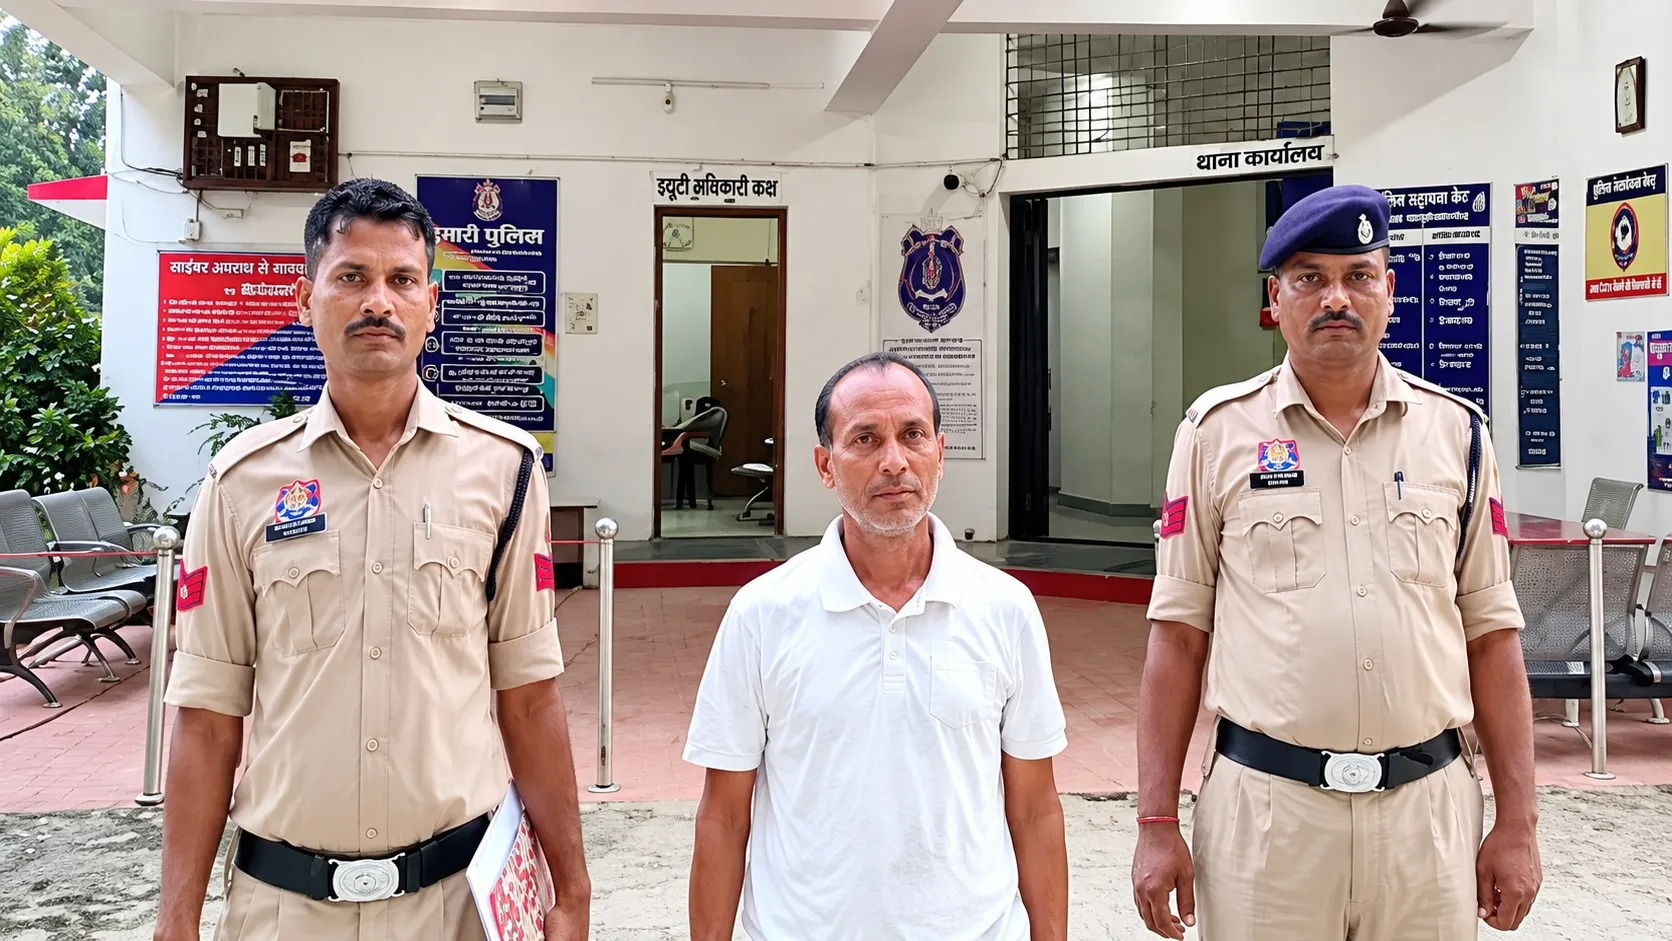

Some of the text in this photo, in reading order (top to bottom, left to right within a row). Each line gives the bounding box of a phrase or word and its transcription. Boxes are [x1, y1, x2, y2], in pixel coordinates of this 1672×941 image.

[1196, 141, 1326, 171] थाना कार्यालय
[751, 179, 779, 198] कक्ष
[257, 258, 270, 275] से
